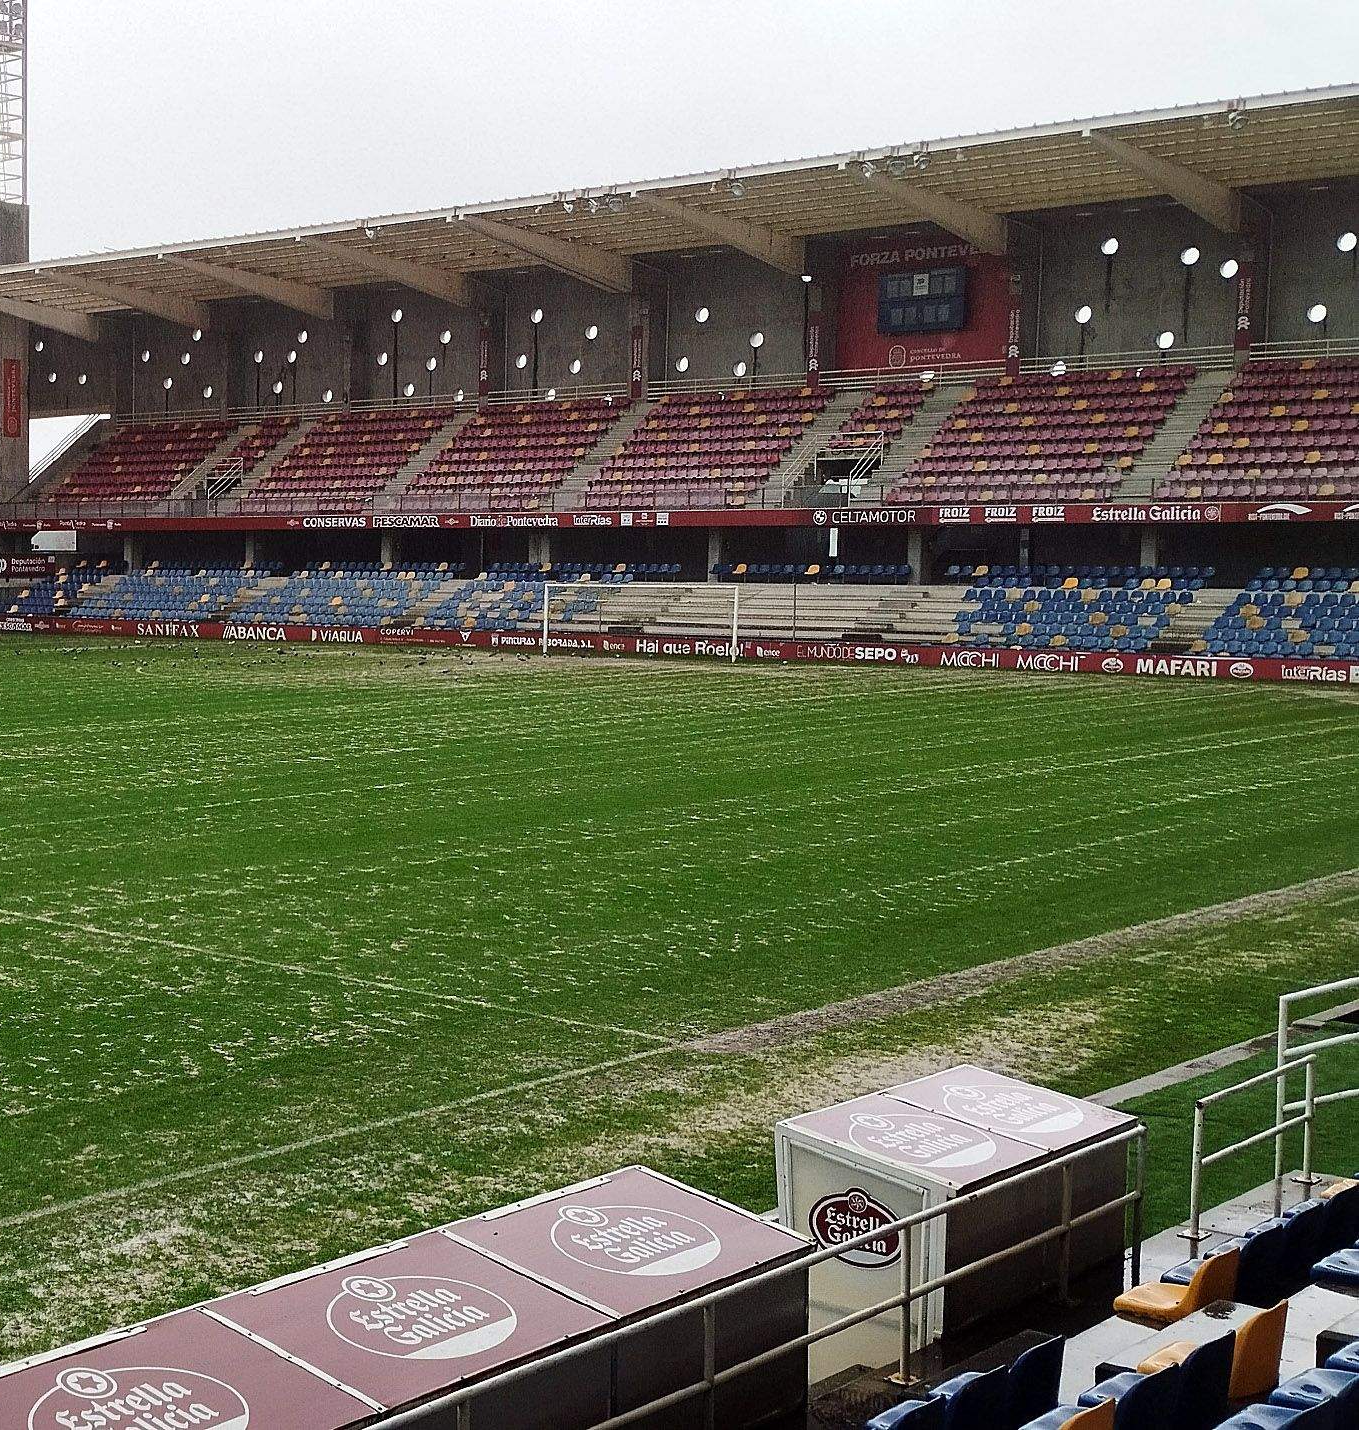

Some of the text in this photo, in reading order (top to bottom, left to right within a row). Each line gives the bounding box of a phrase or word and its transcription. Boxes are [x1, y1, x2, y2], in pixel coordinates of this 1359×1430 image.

[910, 353, 961, 362] PONTEVEDRA
[832, 510, 916, 523] CELTAMOTOR
[939, 508, 970, 517] FROIZ
[985, 507, 1016, 517] FROIZ
[1032, 506, 1064, 516] FROIZ
[1092, 506, 1201, 521] Estrella Galicia
[303, 516, 439, 527] CONSERVAS PESCAMAR
[470, 516, 496, 527] Diario
[507, 516, 558, 527] Pontevedra
[11, 558, 46, 567] Deputación
[501, 637, 536, 646] PINTURAS
[636, 639, 658, 654] Hai
[662, 643, 690, 655] que
[855, 647, 897, 660] SEPO
[1136, 659, 1218, 677] MAFARI
[962, 1091, 1035, 1115] Estrella
[994, 1102, 1060, 1125] Galicia
[867, 1121, 945, 1148] Estrella
[899, 1134, 973, 1158] Galicia
[571, 1216, 668, 1251] Estrella
[827, 1225, 887, 1253] Galia
[604, 1230, 696, 1263] Galicia
[349, 1288, 462, 1331] Estrella
[384, 1305, 490, 1345] Galicia
[55, 1382, 192, 1430] Estrella
